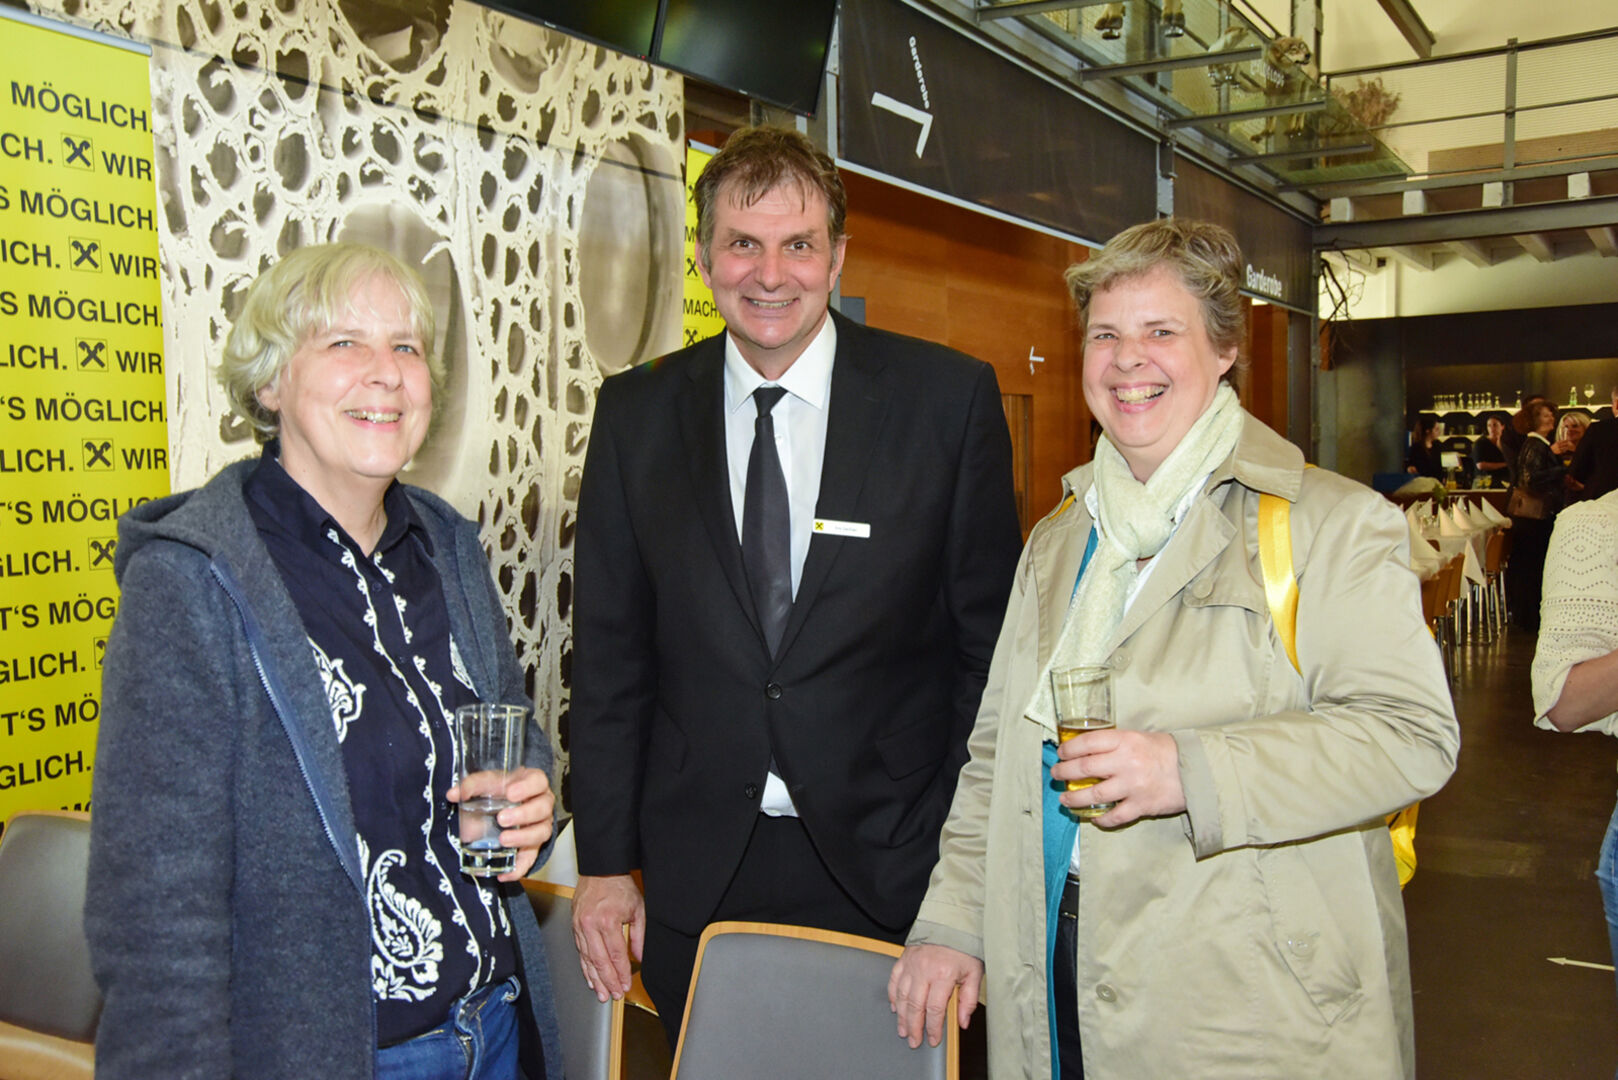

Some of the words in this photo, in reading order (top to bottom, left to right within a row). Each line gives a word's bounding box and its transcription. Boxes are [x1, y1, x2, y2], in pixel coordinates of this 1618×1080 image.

[11, 80, 153, 134] MÖGLICH.
[101, 151, 152, 181] WIR
[20, 188, 158, 232] MÖGLICH.
[109, 252, 157, 280] WIR
[1246, 263, 1282, 298] Garderobe
[28, 290, 164, 328] MÖGLICH.
[115, 350, 162, 375] WIR
[35, 392, 168, 422] MÖGLICH.
[121, 448, 167, 470] WIR
[0, 549, 80, 577] LICH.
[49, 593, 120, 625] MÖG
